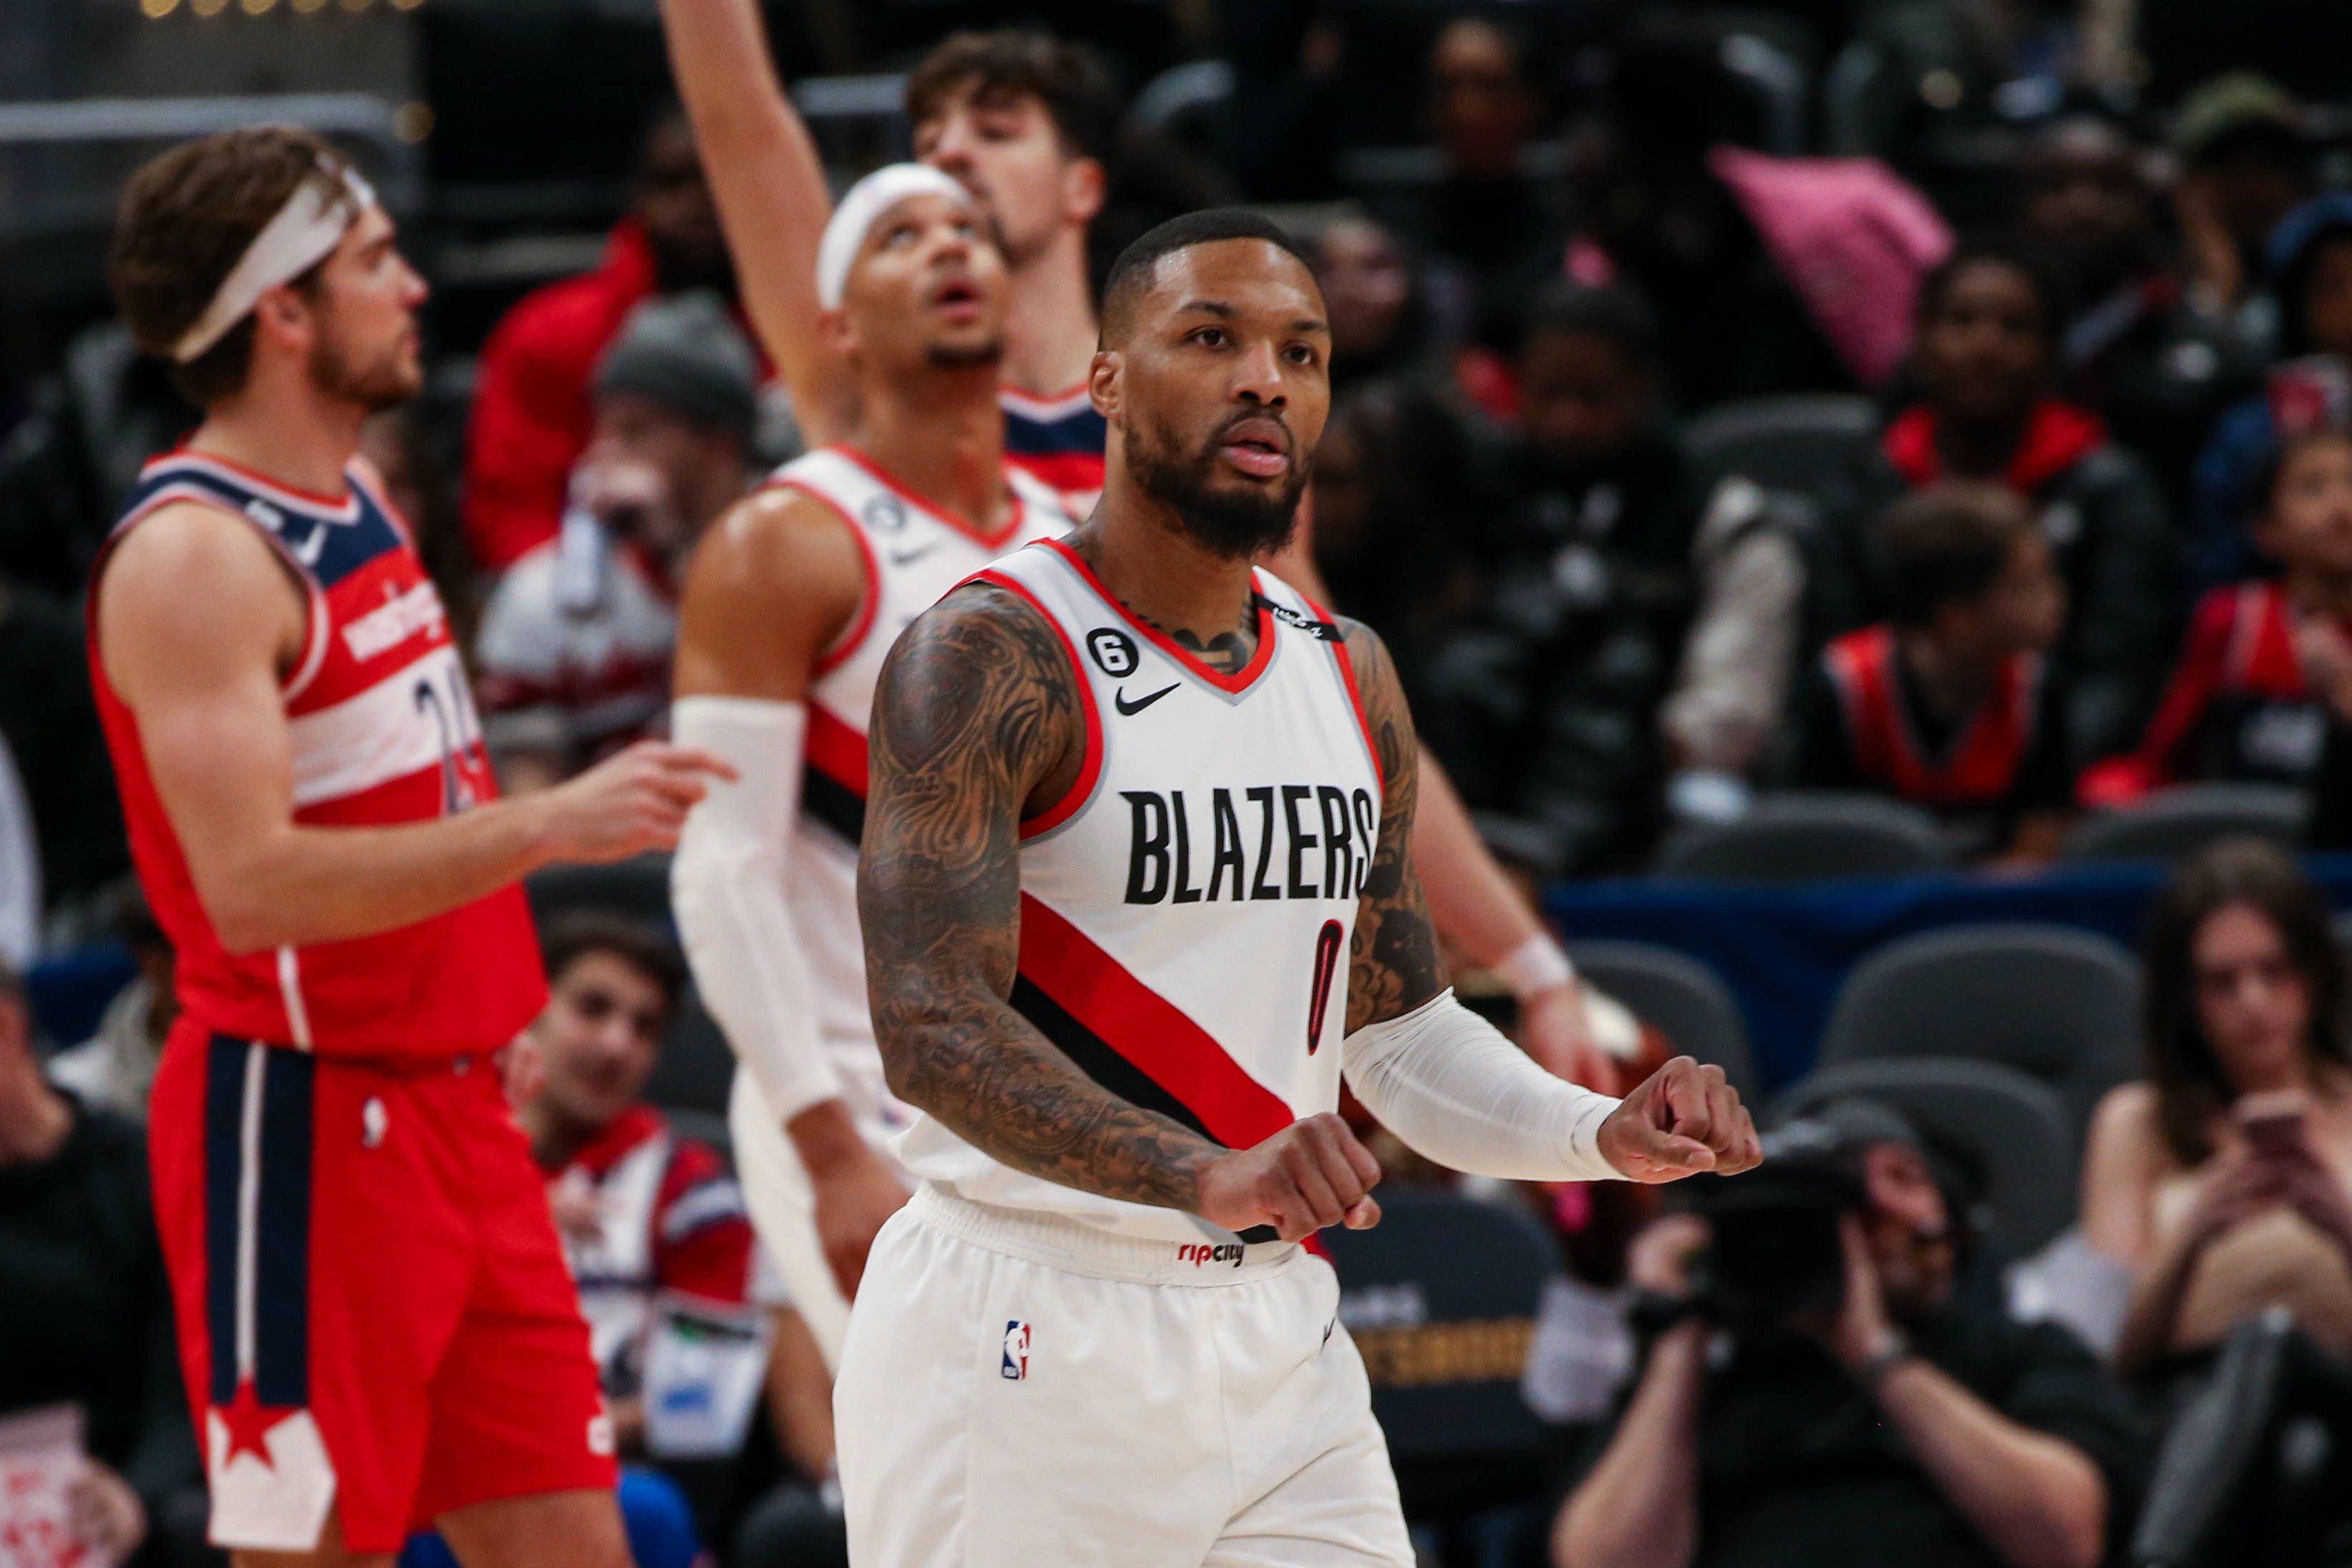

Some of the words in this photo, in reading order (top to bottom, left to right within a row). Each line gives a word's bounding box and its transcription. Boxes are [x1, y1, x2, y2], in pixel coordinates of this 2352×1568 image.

[1093, 635, 1131, 672] 6
[1118, 784, 1373, 904] BLAZERS
[1307, 918, 1343, 1056] 0
